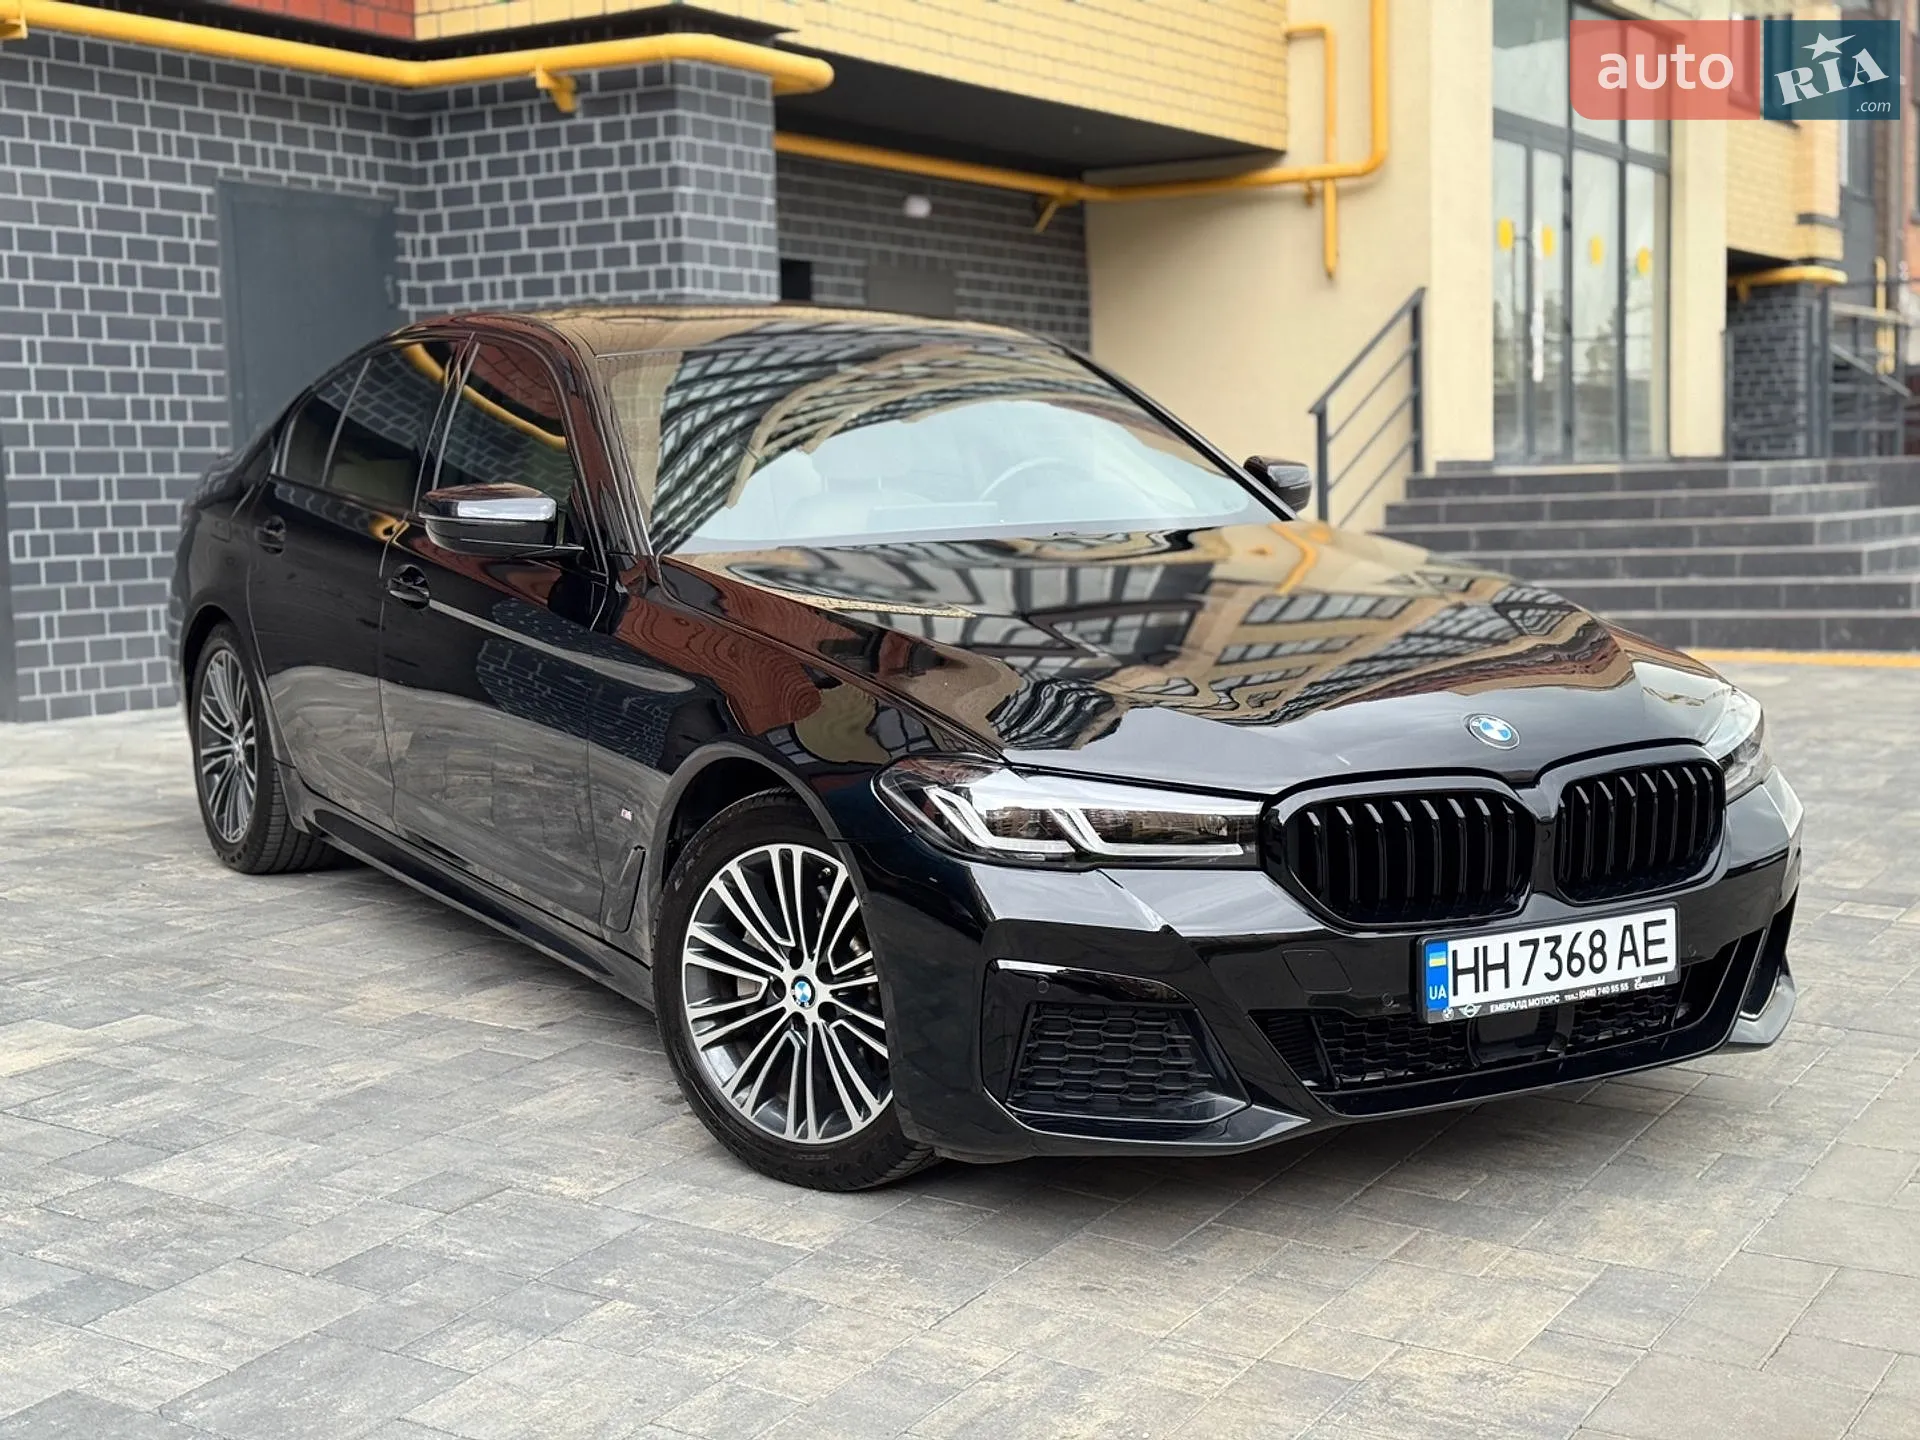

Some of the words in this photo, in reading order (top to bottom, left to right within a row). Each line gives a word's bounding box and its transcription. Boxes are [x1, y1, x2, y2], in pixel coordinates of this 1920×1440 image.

[1519, 929, 1607, 986] 7368
[1429, 984, 1447, 1000] UA
[1490, 1000, 1528, 1013] ЕМЕРАЛД
[1528, 994, 1560, 1007] МОТОРС
